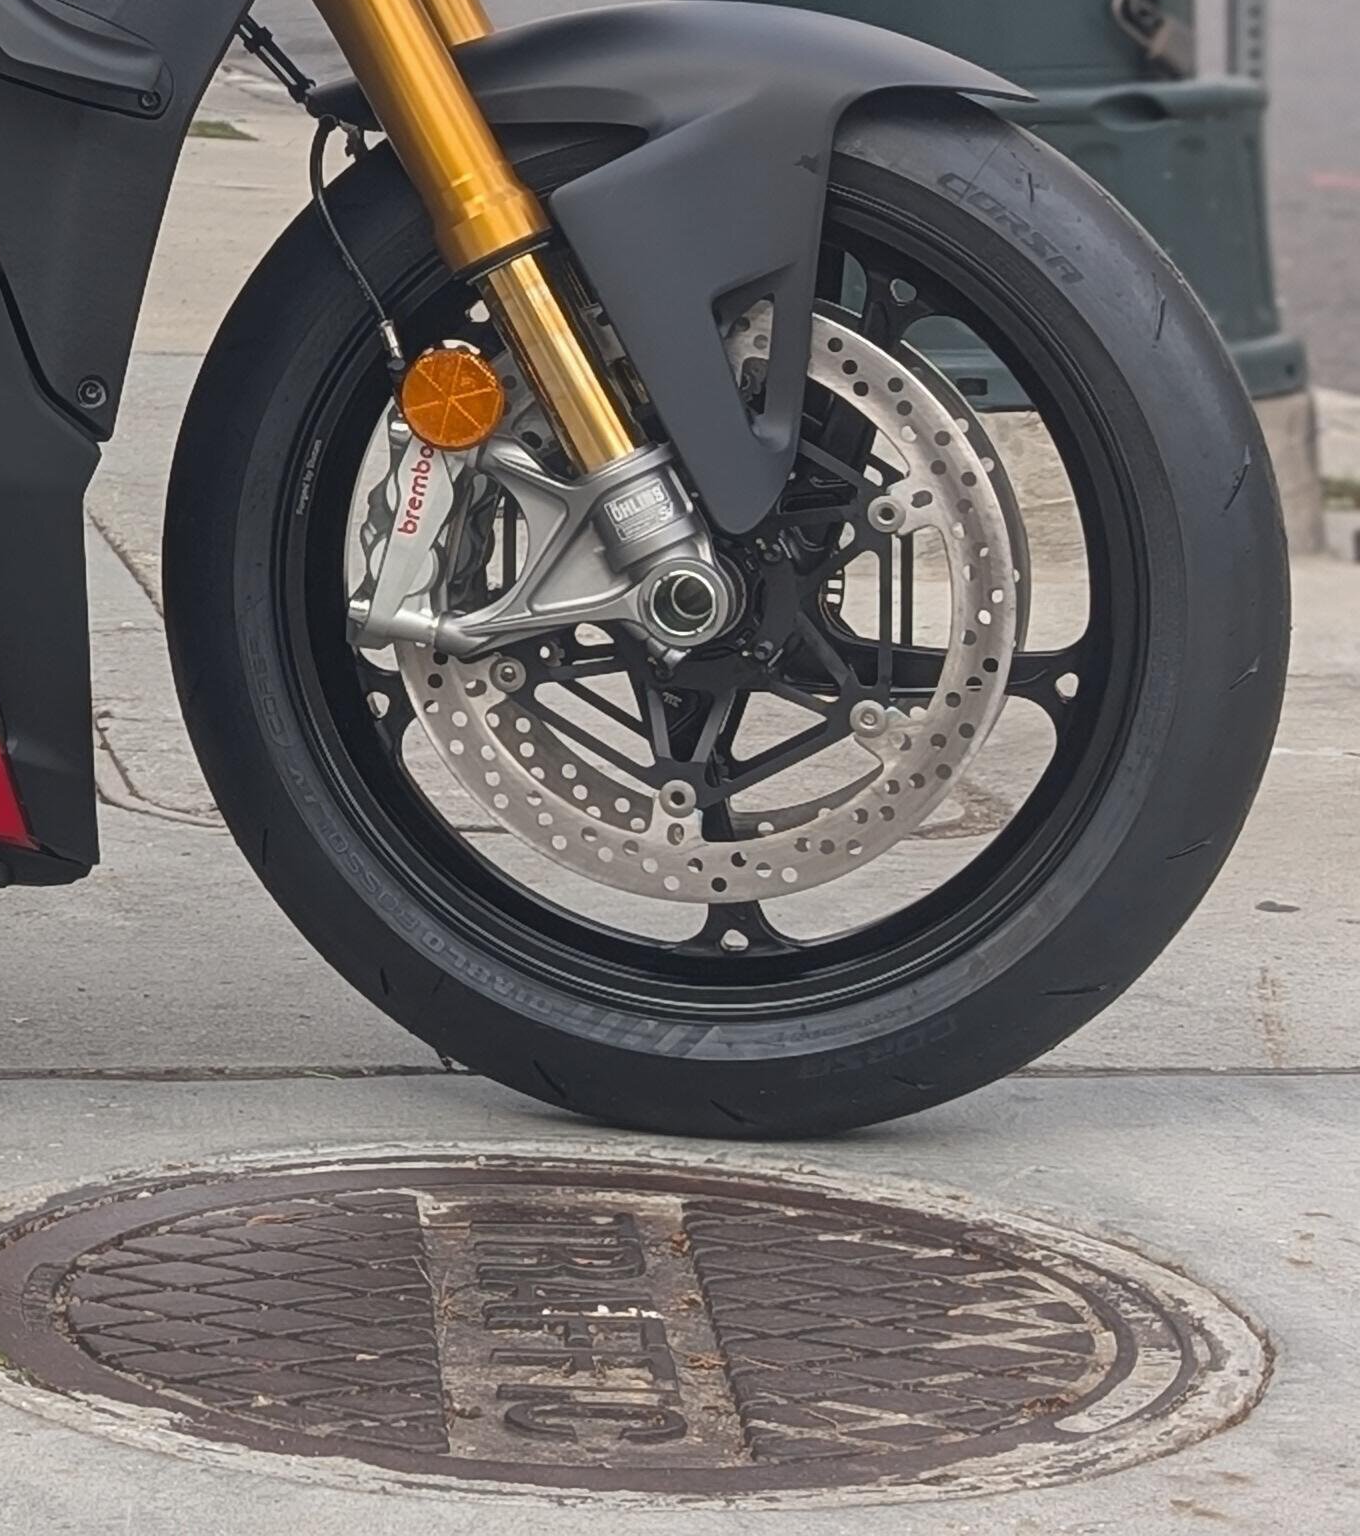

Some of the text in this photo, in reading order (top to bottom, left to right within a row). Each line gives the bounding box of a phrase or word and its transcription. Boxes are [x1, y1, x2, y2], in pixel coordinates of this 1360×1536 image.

[936, 171, 1085, 285] CORSA
[397, 445, 435, 535] brembo
[326, 830, 423, 936] ROSSO
[420, 929, 555, 1016] DIABLO
[470, 1213, 688, 1443] TRAFFIC
